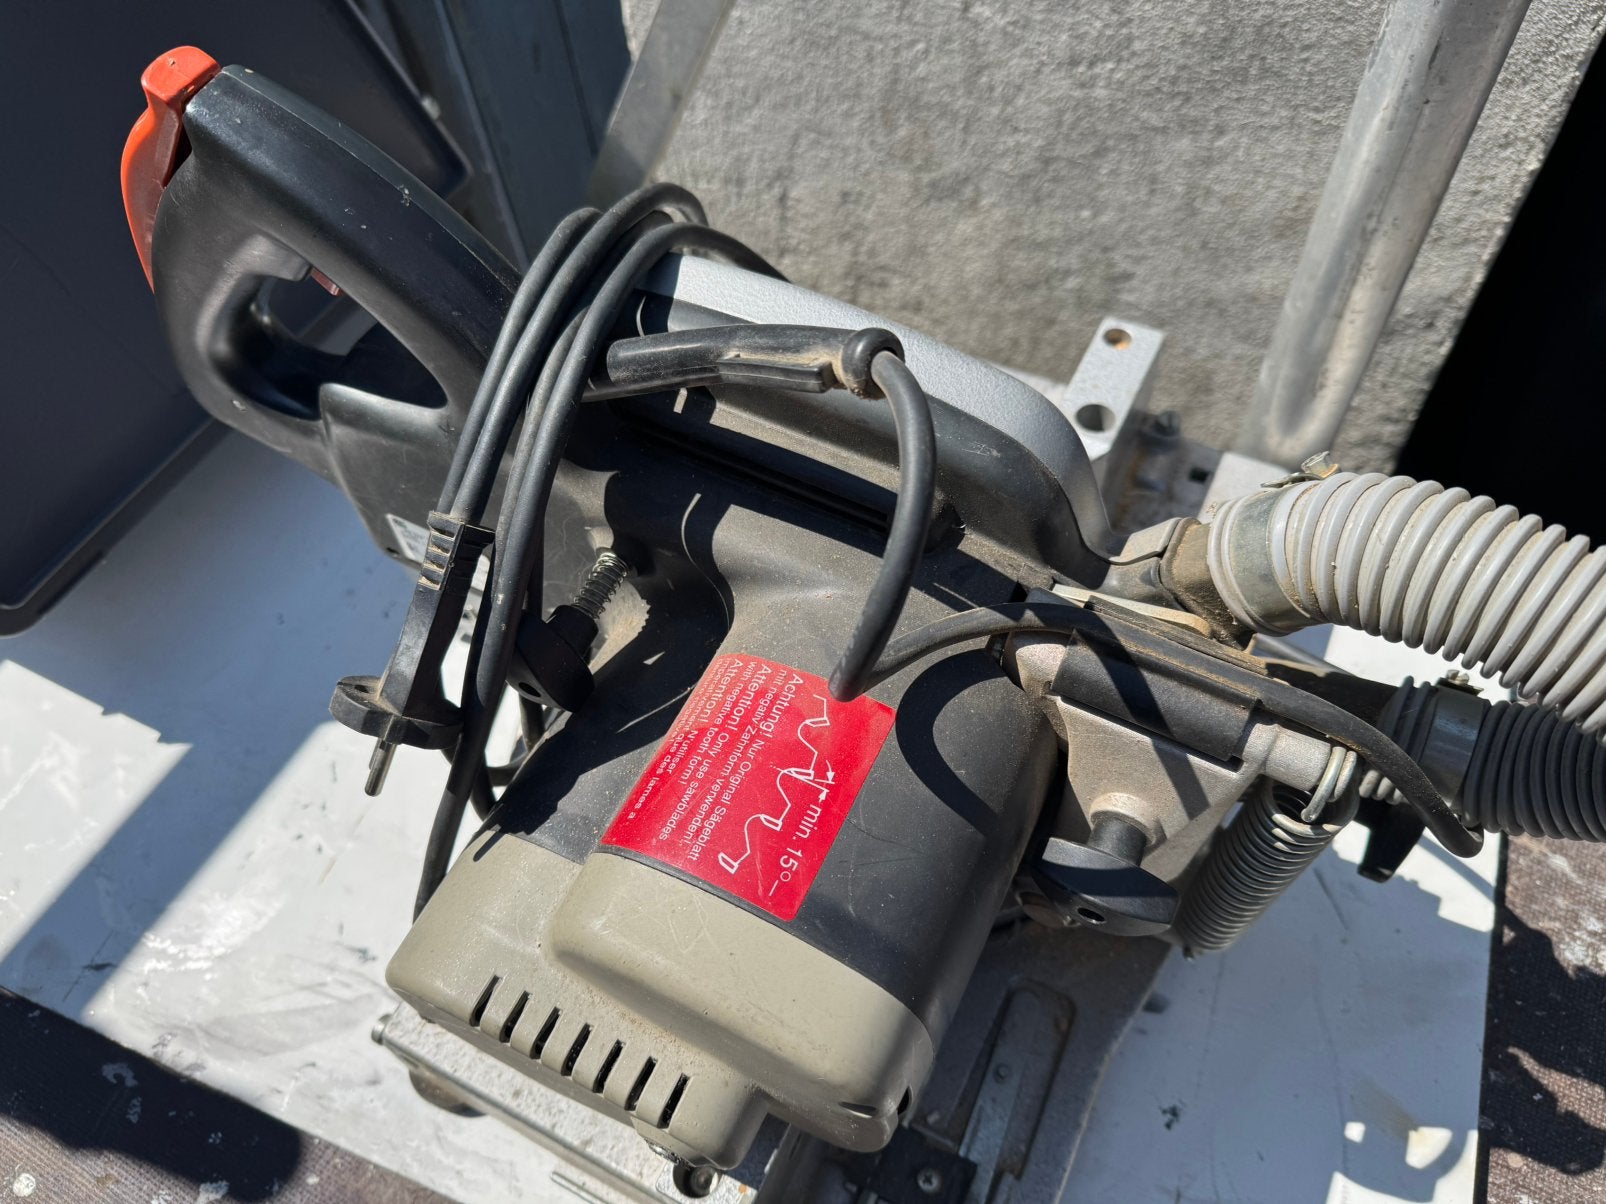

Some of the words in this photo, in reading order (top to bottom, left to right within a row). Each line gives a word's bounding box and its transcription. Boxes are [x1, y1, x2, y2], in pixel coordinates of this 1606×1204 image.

[739, 660, 757, 682] with
[772, 668, 787, 685] mit
[697, 657, 743, 722] Attention!
[713, 682, 744, 725] negative
[724, 663, 772, 730] Attention!
[751, 686, 778, 723] negativ
[758, 673, 803, 738] Achtung!
[668, 732, 684, 752] que
[696, 726, 719, 751] tooth
[707, 732, 728, 758] Only
[719, 723, 757, 775] Zahnform
[746, 737, 764, 759] Nur
[655, 754, 670, 774] des
[677, 754, 701, 785] form!
[694, 758, 712, 779] use
[633, 777, 659, 809] lames
[720, 761, 751, 805] Original
[657, 780, 699, 841] sawblades
[680, 778, 725, 843] verwenden!
[791, 803, 822, 839] min.
[687, 804, 726, 861] Sägeblatt
